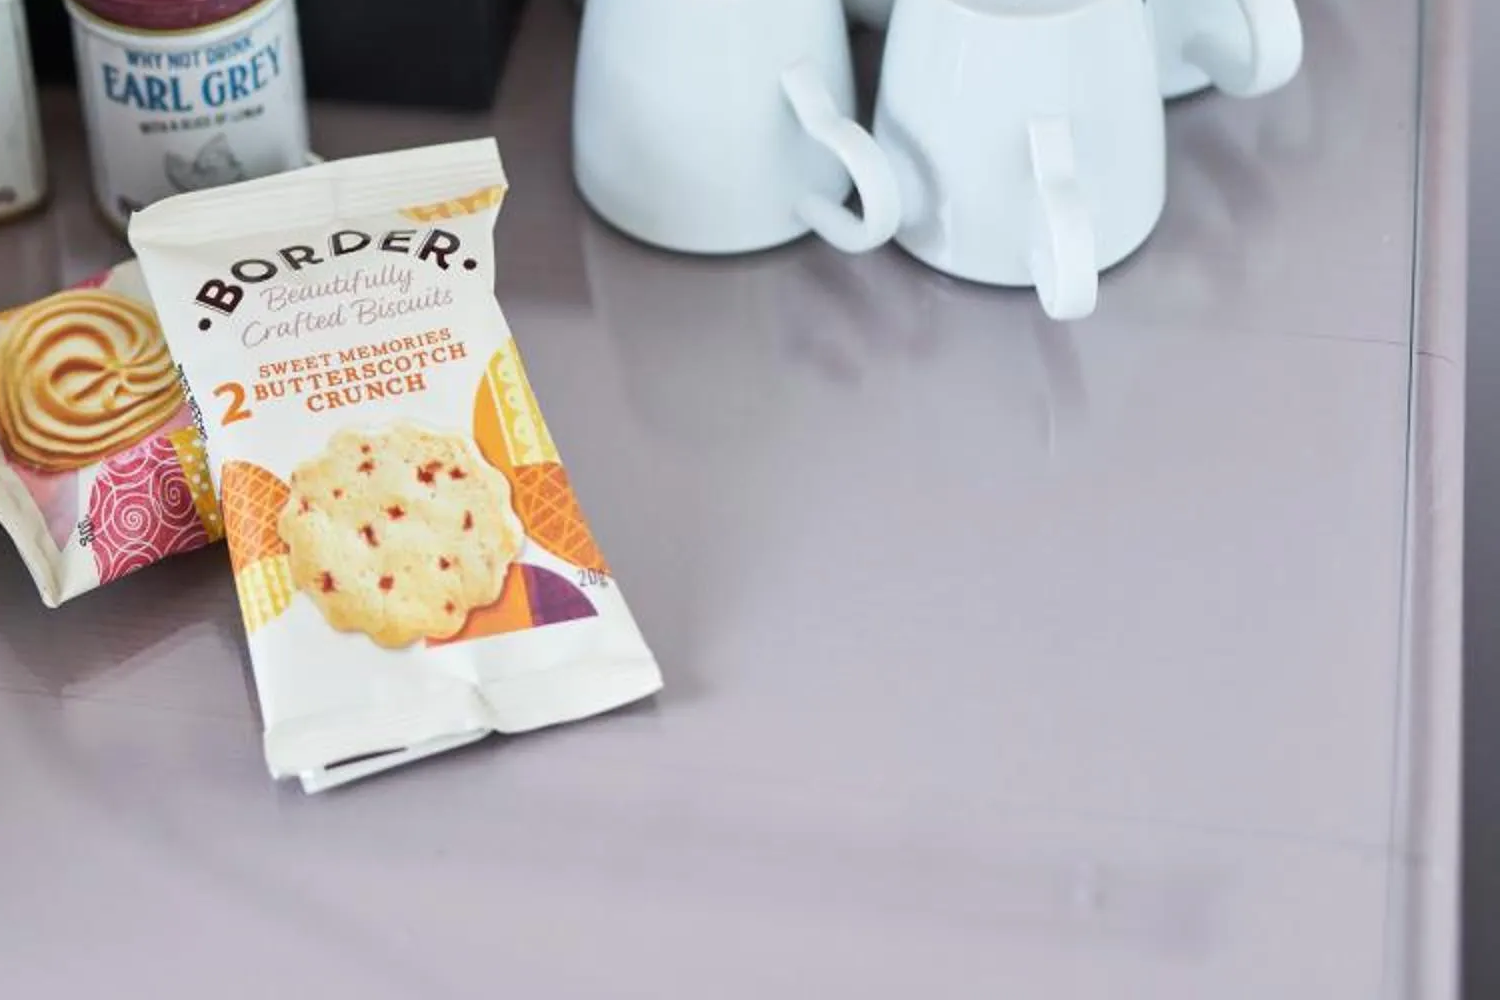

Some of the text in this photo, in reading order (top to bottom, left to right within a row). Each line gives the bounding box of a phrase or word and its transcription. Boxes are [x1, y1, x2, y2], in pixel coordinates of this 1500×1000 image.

[102, 35, 283, 112] EARL GREY
[125, 48, 162, 69] WHY
[167, 49, 201, 70] NOT
[259, 264, 414, 312] Beautifully
[241, 288, 454, 348] Crafted Biscuits
[253, 341, 467, 402] BUTTERSCOTCH
[259, 327, 452, 379] SWEET MEMORIES
[212, 381, 252, 426] 2
[306, 373, 426, 413] CRUNCH
